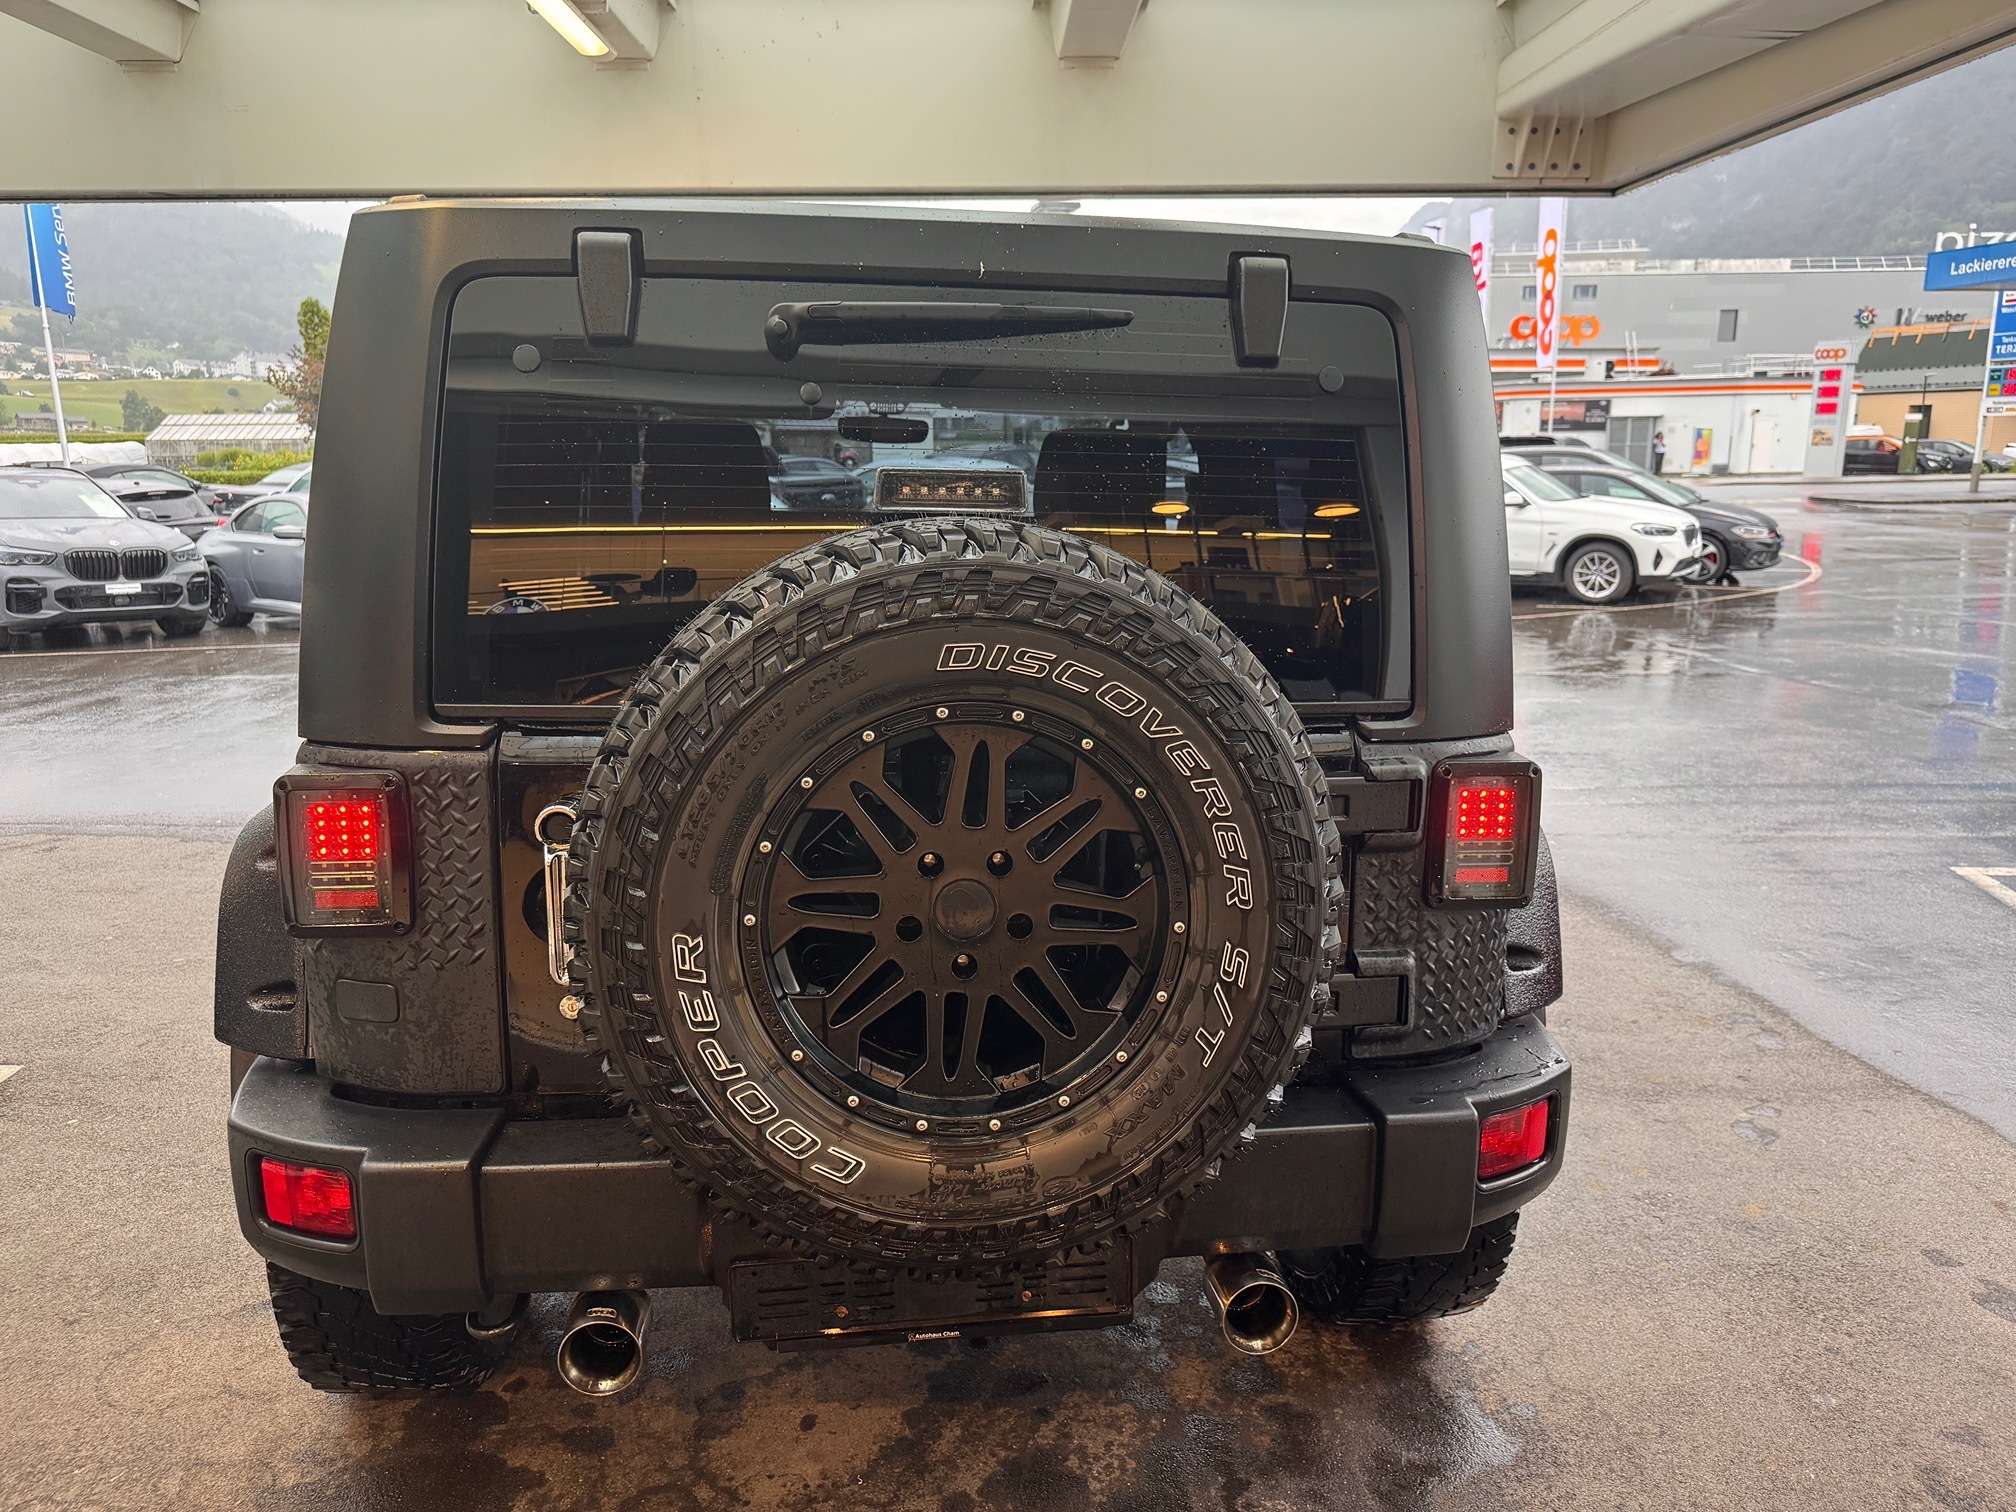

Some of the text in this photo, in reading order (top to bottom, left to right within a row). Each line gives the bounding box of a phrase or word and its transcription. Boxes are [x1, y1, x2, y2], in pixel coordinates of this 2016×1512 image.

[1935, 223, 2016, 252] piz
[58, 249, 76, 306] BMW
[1537, 228, 1558, 356] coop
[1925, 310, 1967, 322] weber
[1815, 349, 1847, 361] coop
[937, 642, 1253, 910] DISCOVERER
[1195, 940, 1249, 1068] S/T
[672, 934, 866, 1184] COOPER
[1104, 1063, 1188, 1139] MAXX
